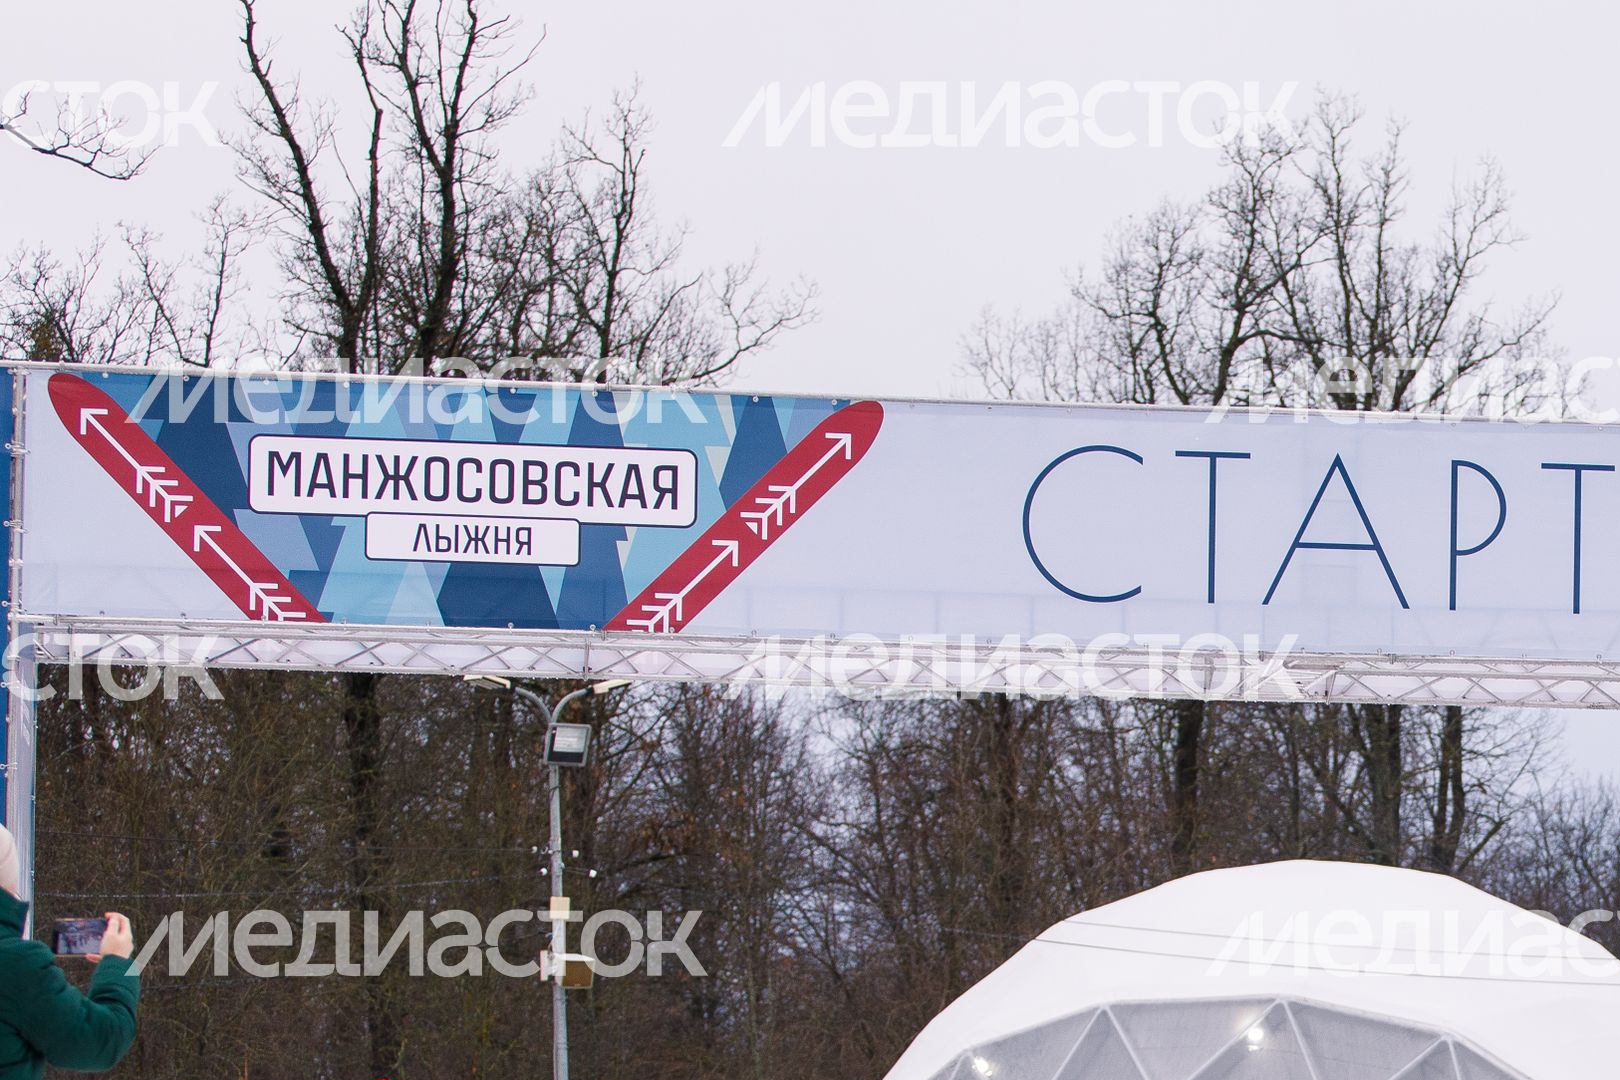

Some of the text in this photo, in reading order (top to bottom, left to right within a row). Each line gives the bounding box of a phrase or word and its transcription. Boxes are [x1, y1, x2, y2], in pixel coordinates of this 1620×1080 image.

[267, 449, 681, 511] МАНЖОСОВСКАЯ
[411, 520, 533, 557] ЛЫЖНЯ
[1022, 444, 1616, 615] СТАРТ
